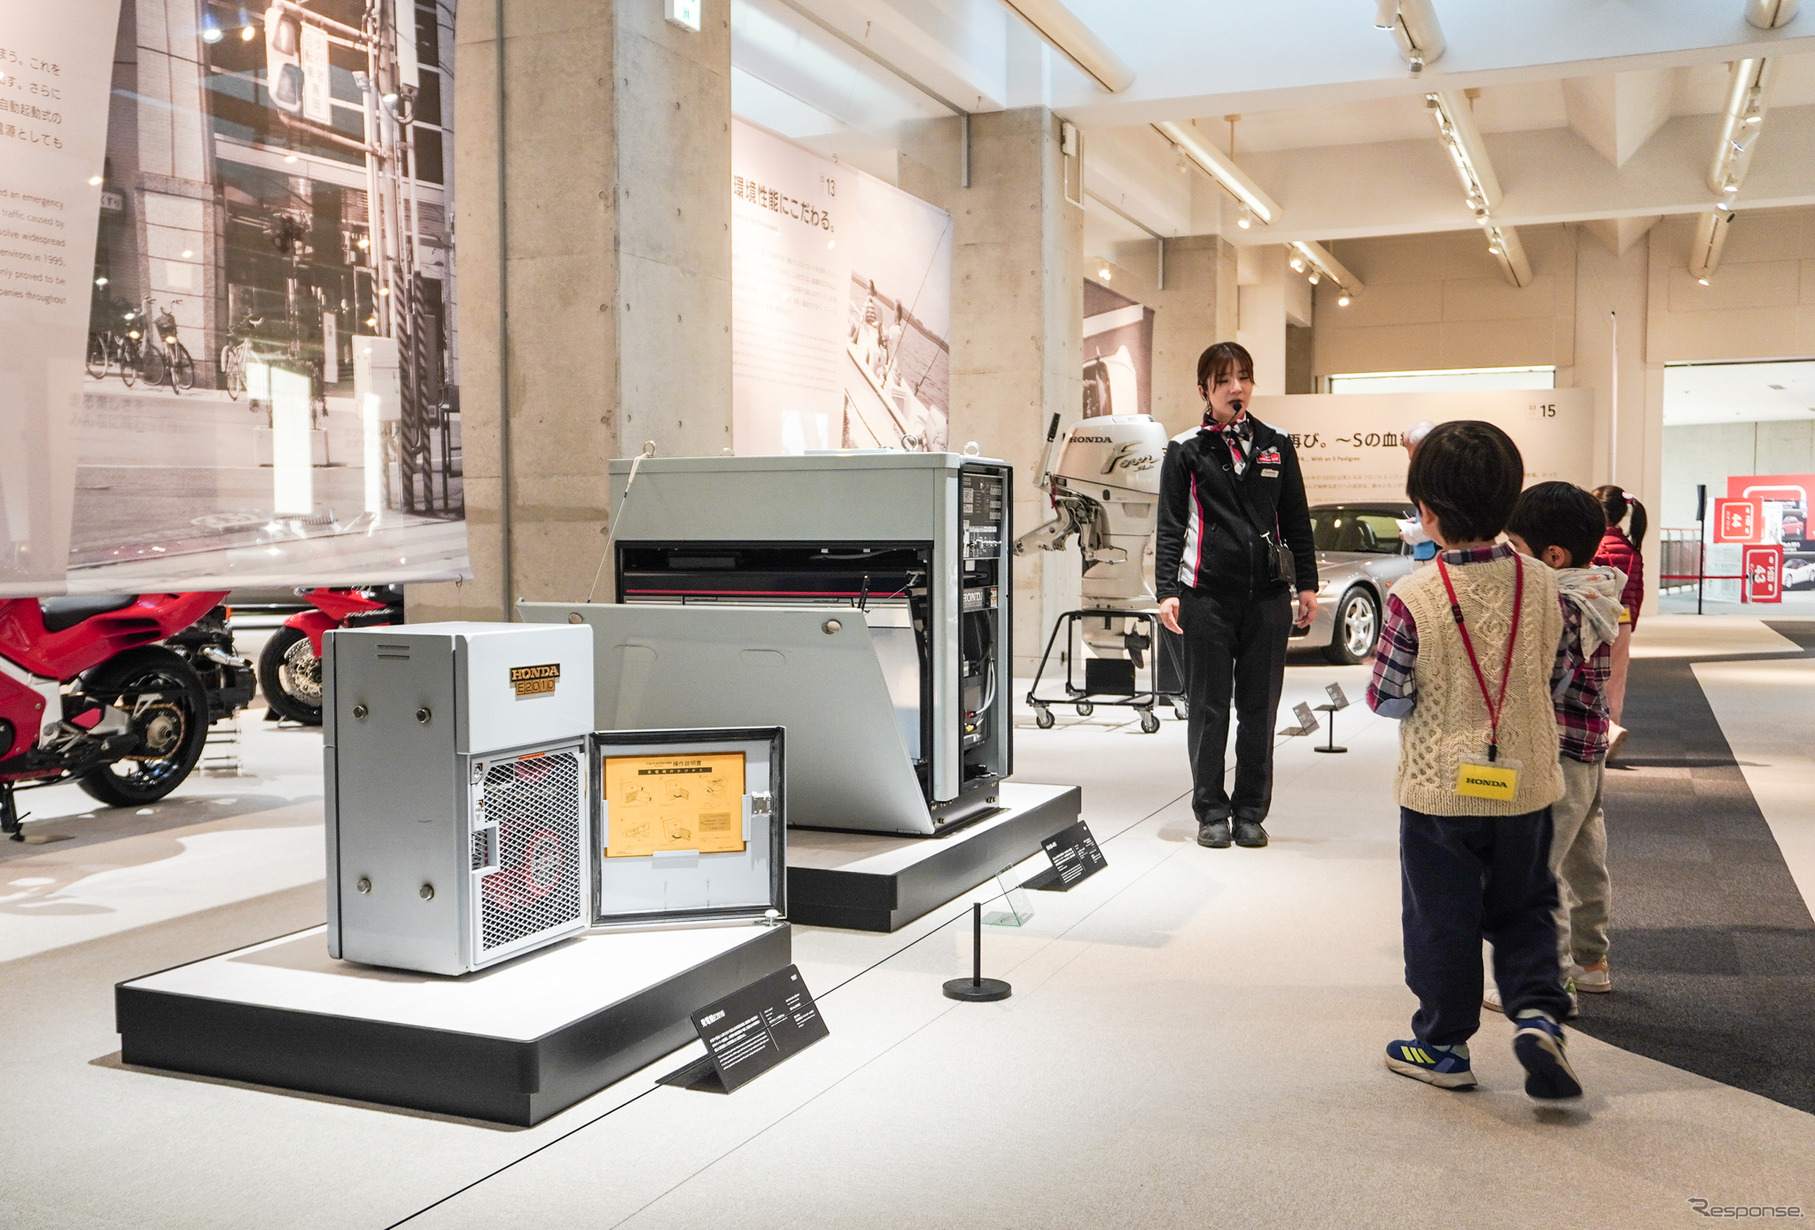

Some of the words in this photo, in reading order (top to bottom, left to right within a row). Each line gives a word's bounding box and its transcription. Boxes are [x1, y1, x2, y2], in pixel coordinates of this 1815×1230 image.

[826, 178, 836, 197] 13
[733, 175, 835, 233] 環境性能にこだわる。
[1540, 405, 1556, 417] 15
[1068, 436, 1113, 444] HONDA
[1290, 432, 1404, 449] 再び。～Sの血
[511, 665, 559, 681] HONDA
[517, 679, 554, 694] E2010
[1466, 777, 1508, 788] HONDA
